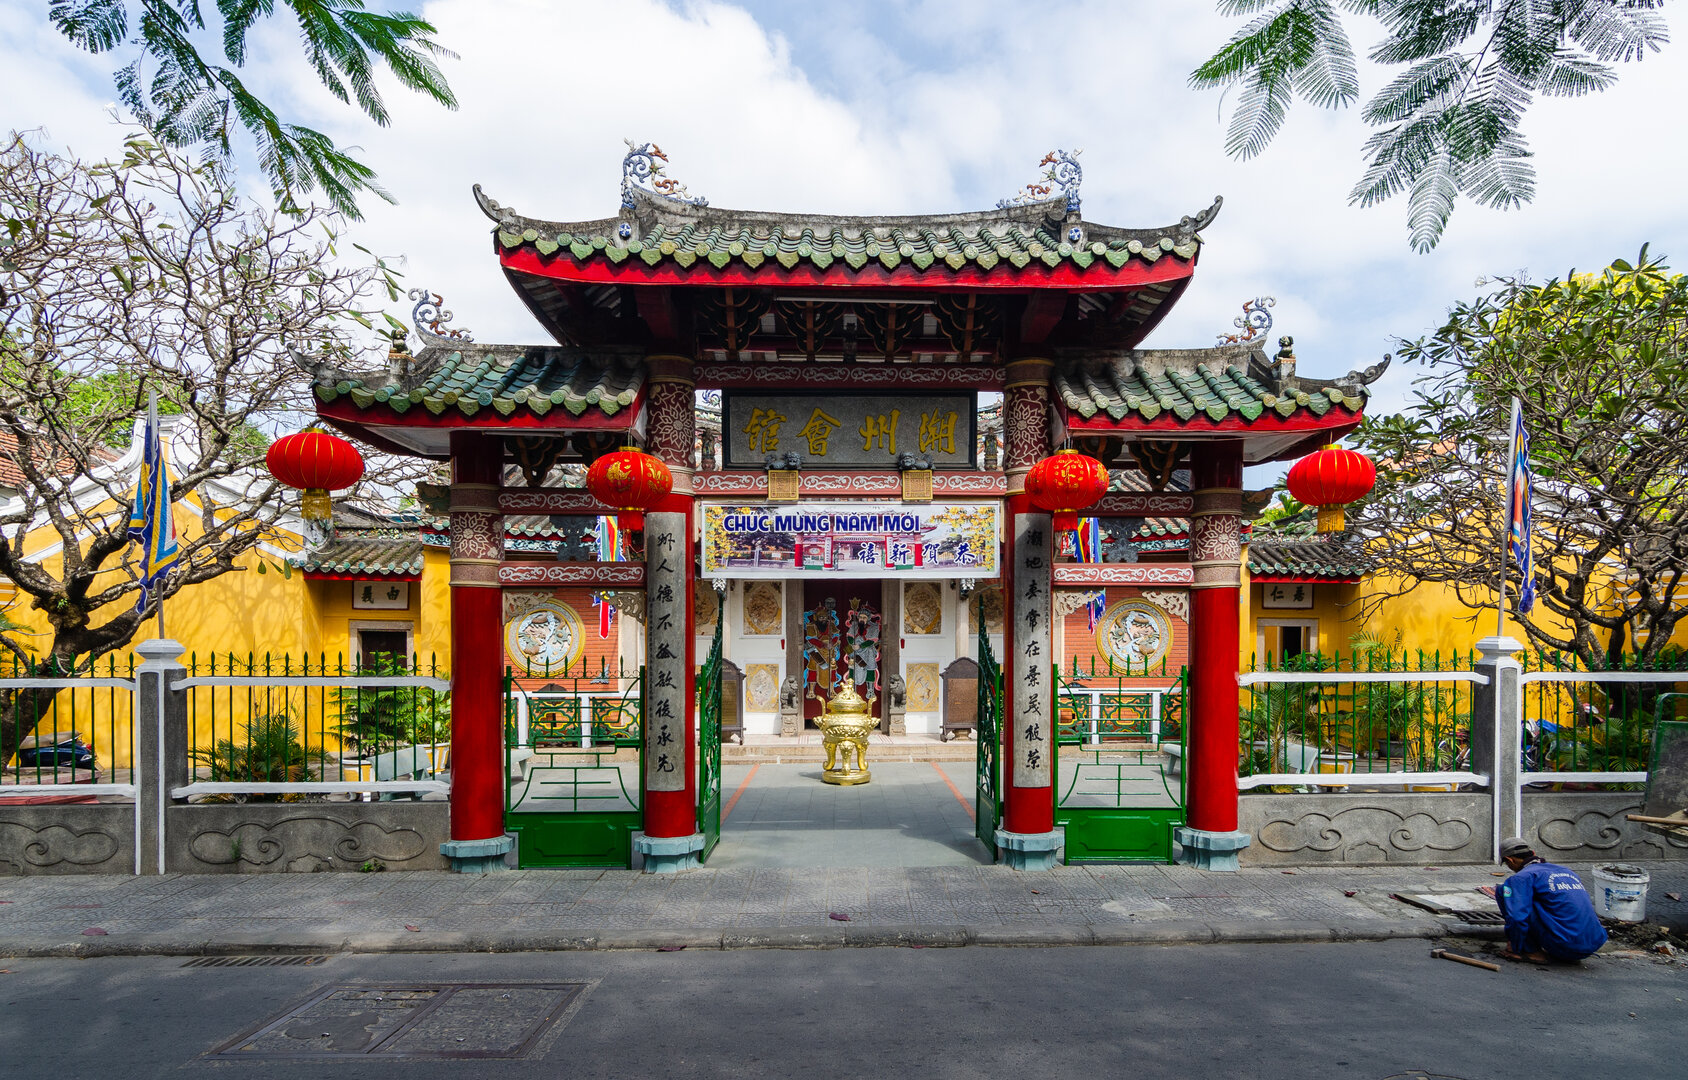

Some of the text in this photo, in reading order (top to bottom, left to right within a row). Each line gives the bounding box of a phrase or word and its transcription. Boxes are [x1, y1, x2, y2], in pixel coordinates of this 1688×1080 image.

[724, 512, 920, 532] CHÚC MỪNG NĂM MỚI
